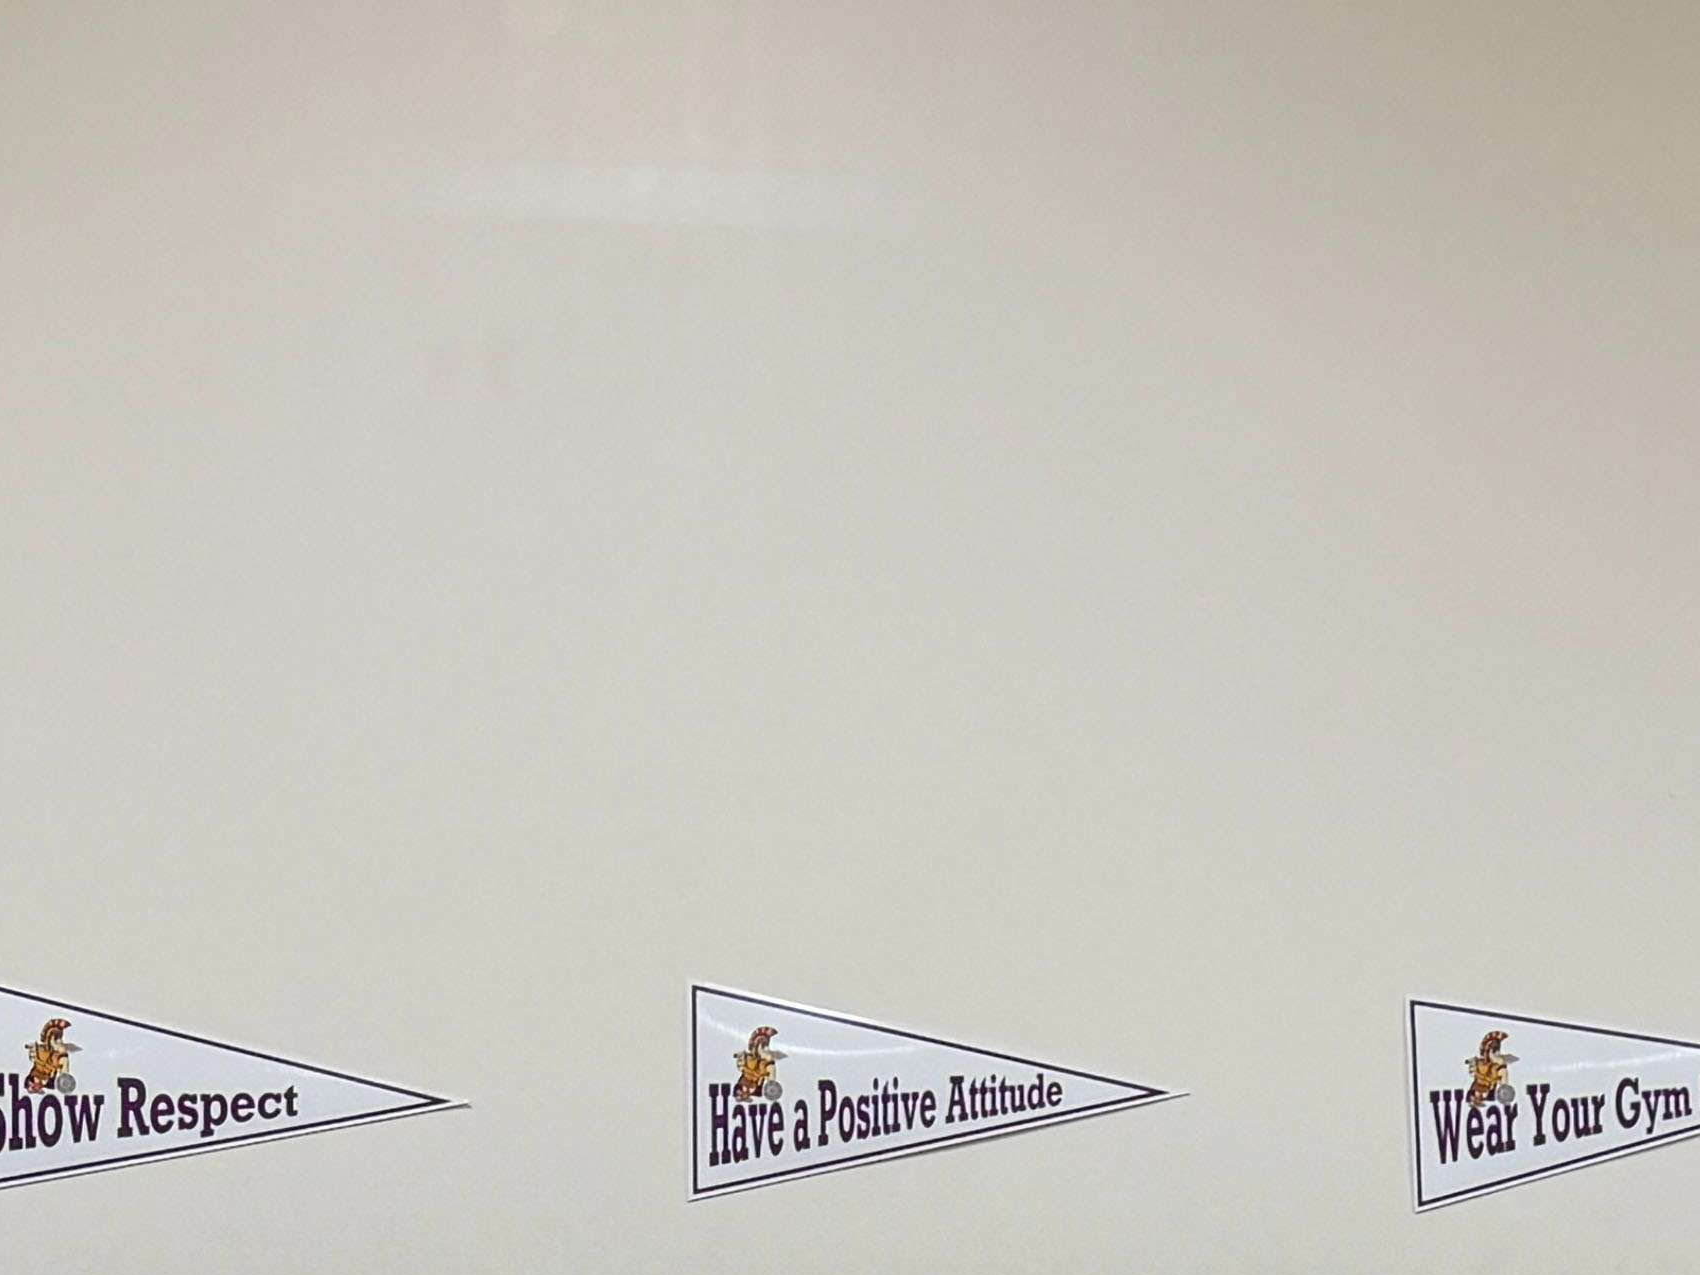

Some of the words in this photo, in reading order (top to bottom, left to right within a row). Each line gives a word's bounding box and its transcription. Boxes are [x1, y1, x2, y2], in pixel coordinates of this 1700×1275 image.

[117, 1077, 299, 1139] Respect
[708, 1083, 785, 1167] Have
[793, 1100, 811, 1152] a
[817, 1077, 937, 1147] Positive
[945, 1073, 1064, 1124] Attitude
[1430, 1089, 1518, 1164] Wear
[1526, 1083, 1606, 1146] Your
[1615, 1077, 1693, 1134] Gym
